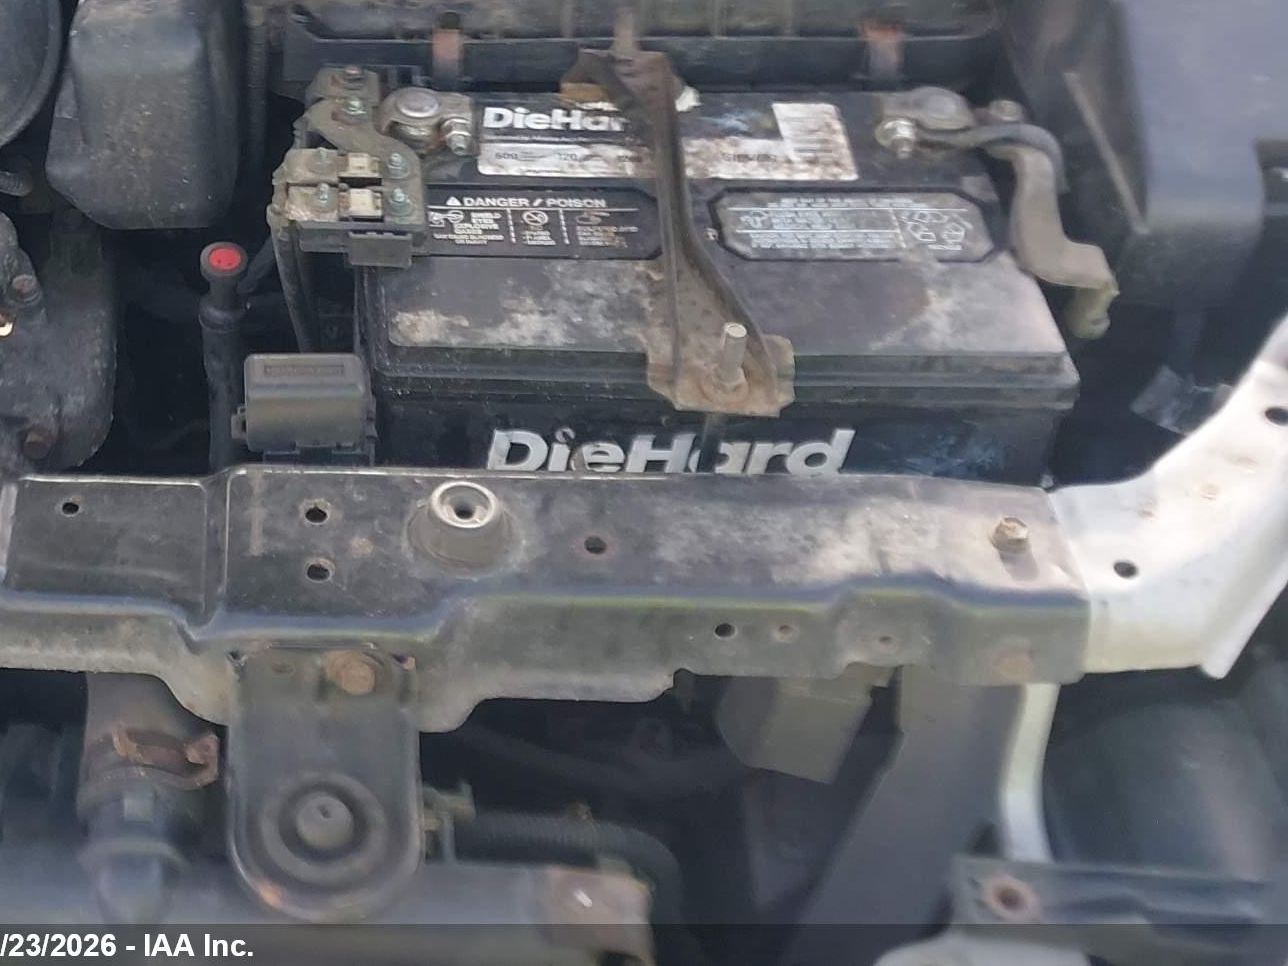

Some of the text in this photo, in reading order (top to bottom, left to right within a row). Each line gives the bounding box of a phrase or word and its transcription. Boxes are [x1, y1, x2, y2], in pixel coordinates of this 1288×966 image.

[482, 106, 631, 132] DieHar
[462, 197, 530, 207] DANGER
[545, 197, 607, 208] POISON
[486, 427, 856, 474] DieHard
